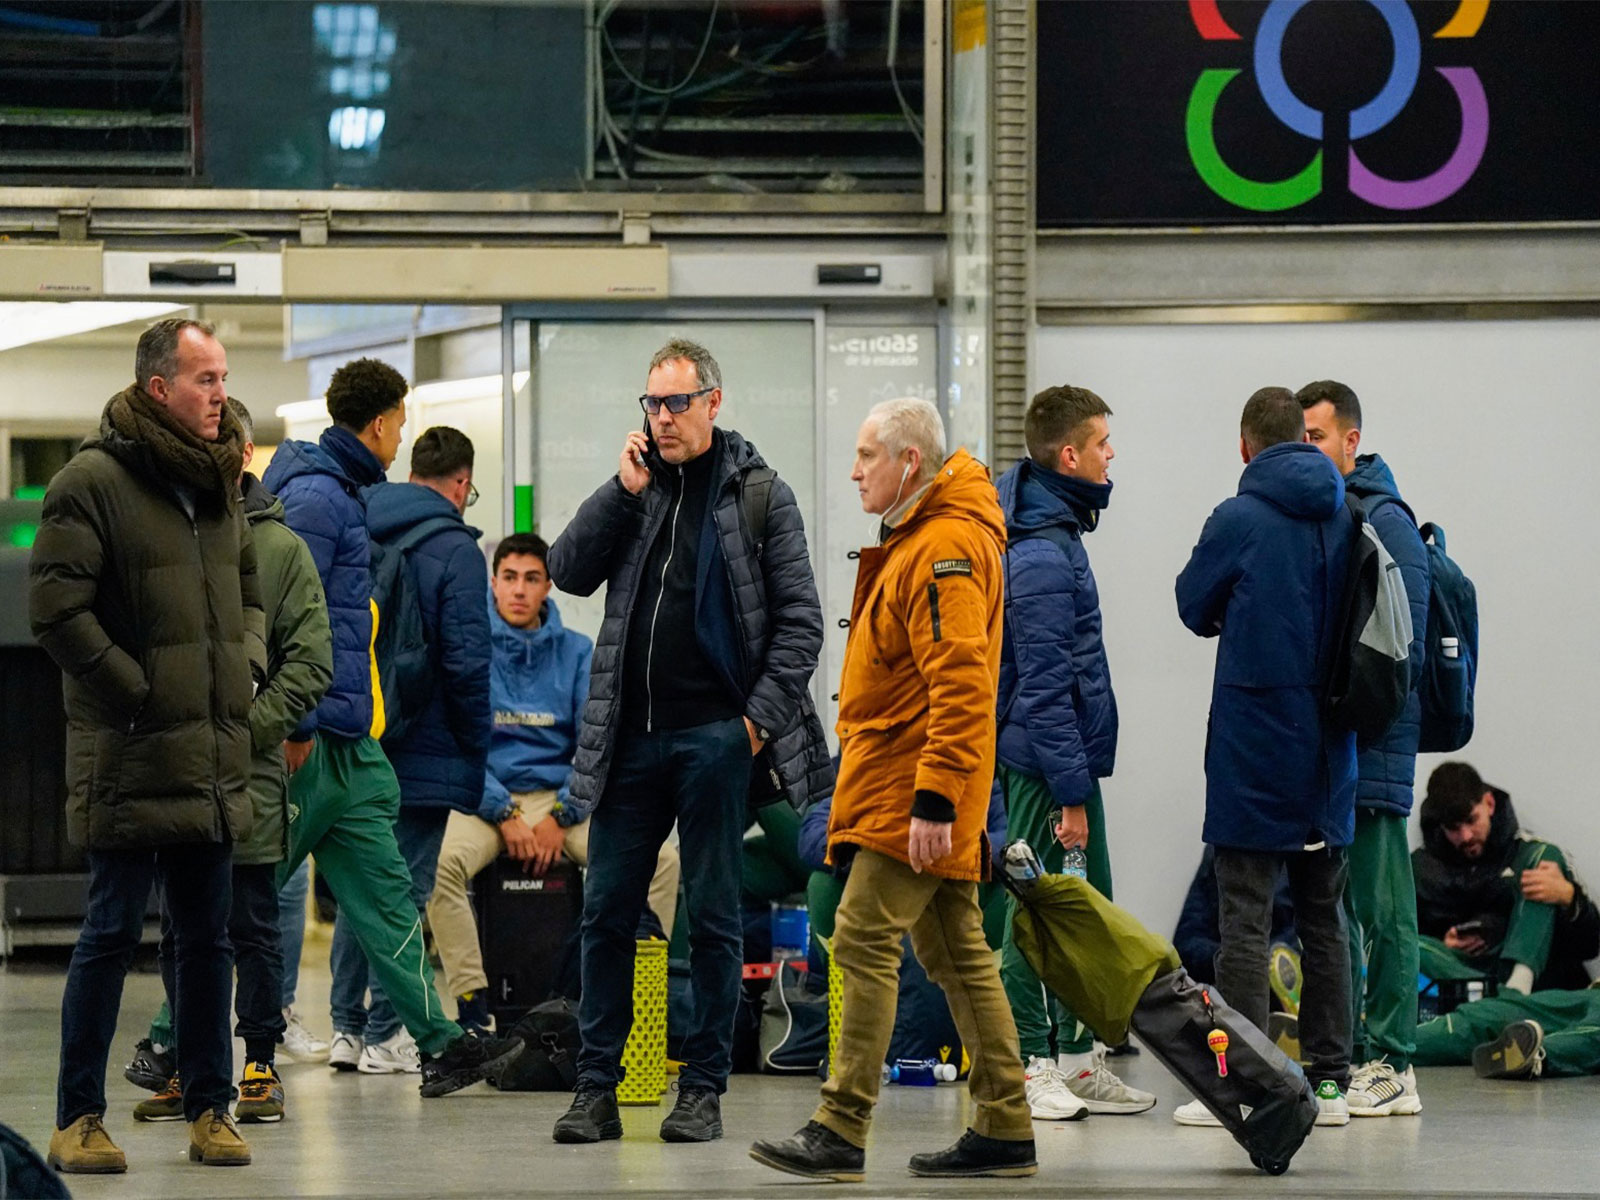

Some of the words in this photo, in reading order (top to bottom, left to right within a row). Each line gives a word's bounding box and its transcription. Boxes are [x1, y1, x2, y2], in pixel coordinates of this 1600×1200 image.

[845, 354, 858, 366] de
[861, 354, 871, 366] la
[873, 353, 918, 366] estación
[502, 879, 544, 891] PELICAN
